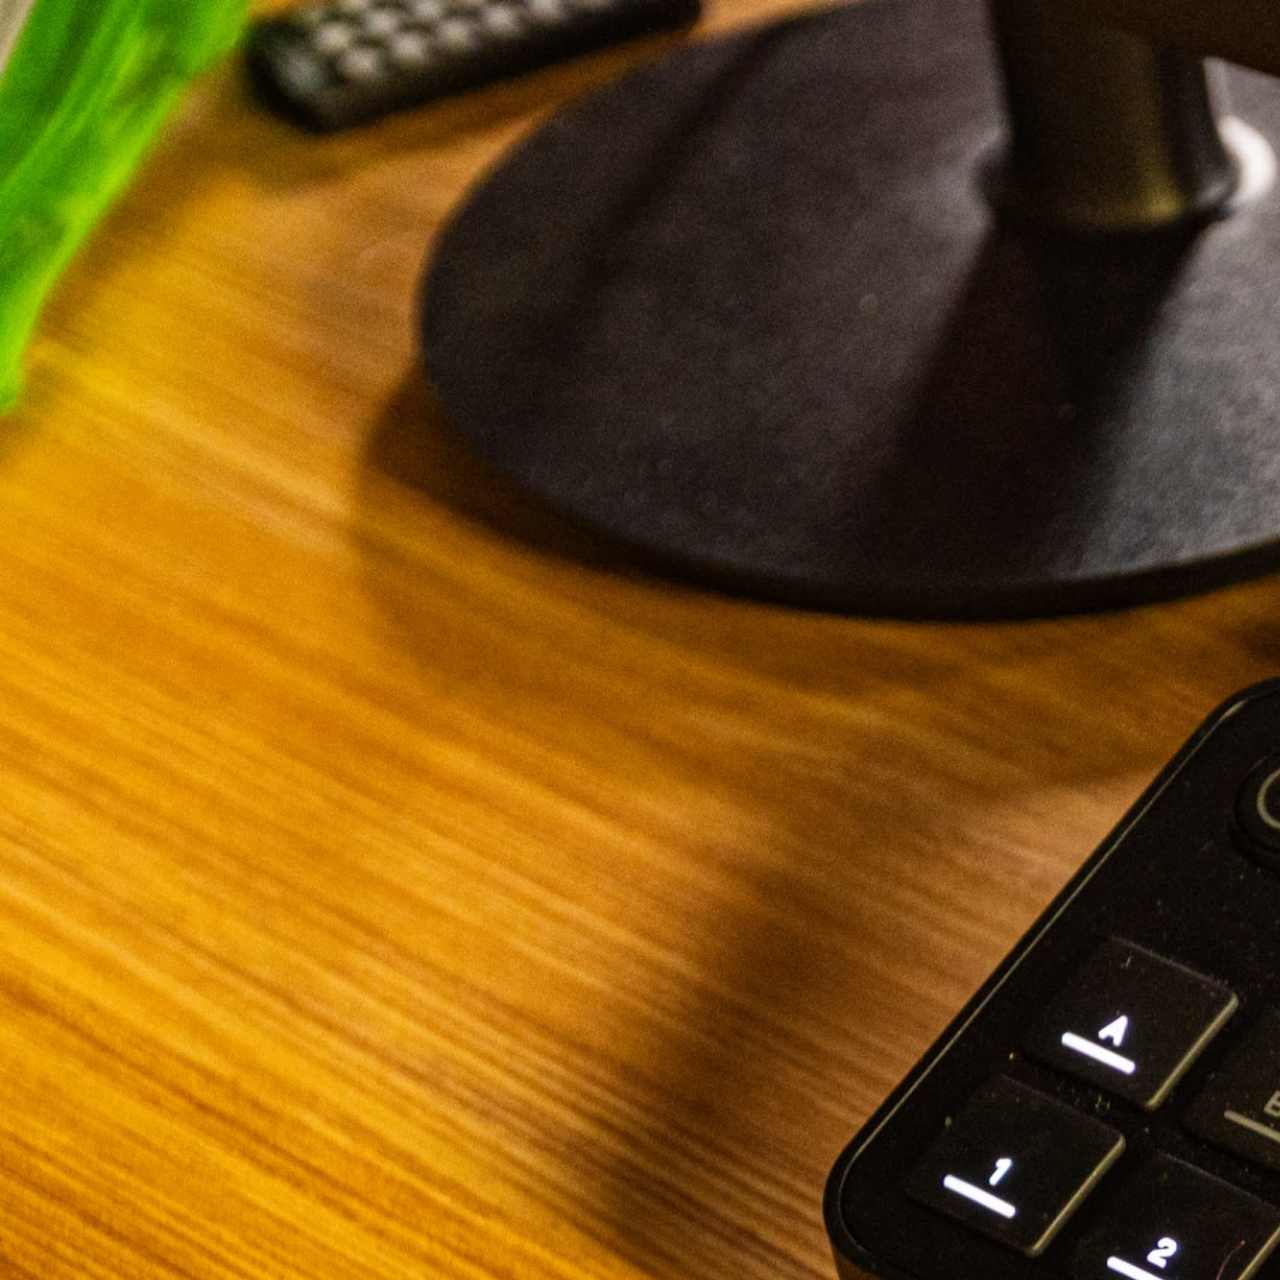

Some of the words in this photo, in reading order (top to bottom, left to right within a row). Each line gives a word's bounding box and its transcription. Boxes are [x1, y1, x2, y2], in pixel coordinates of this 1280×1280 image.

[1098, 1015, 1129, 1048] A
[988, 1157, 1013, 1186] 1
[1147, 1236, 1180, 1269] 2
